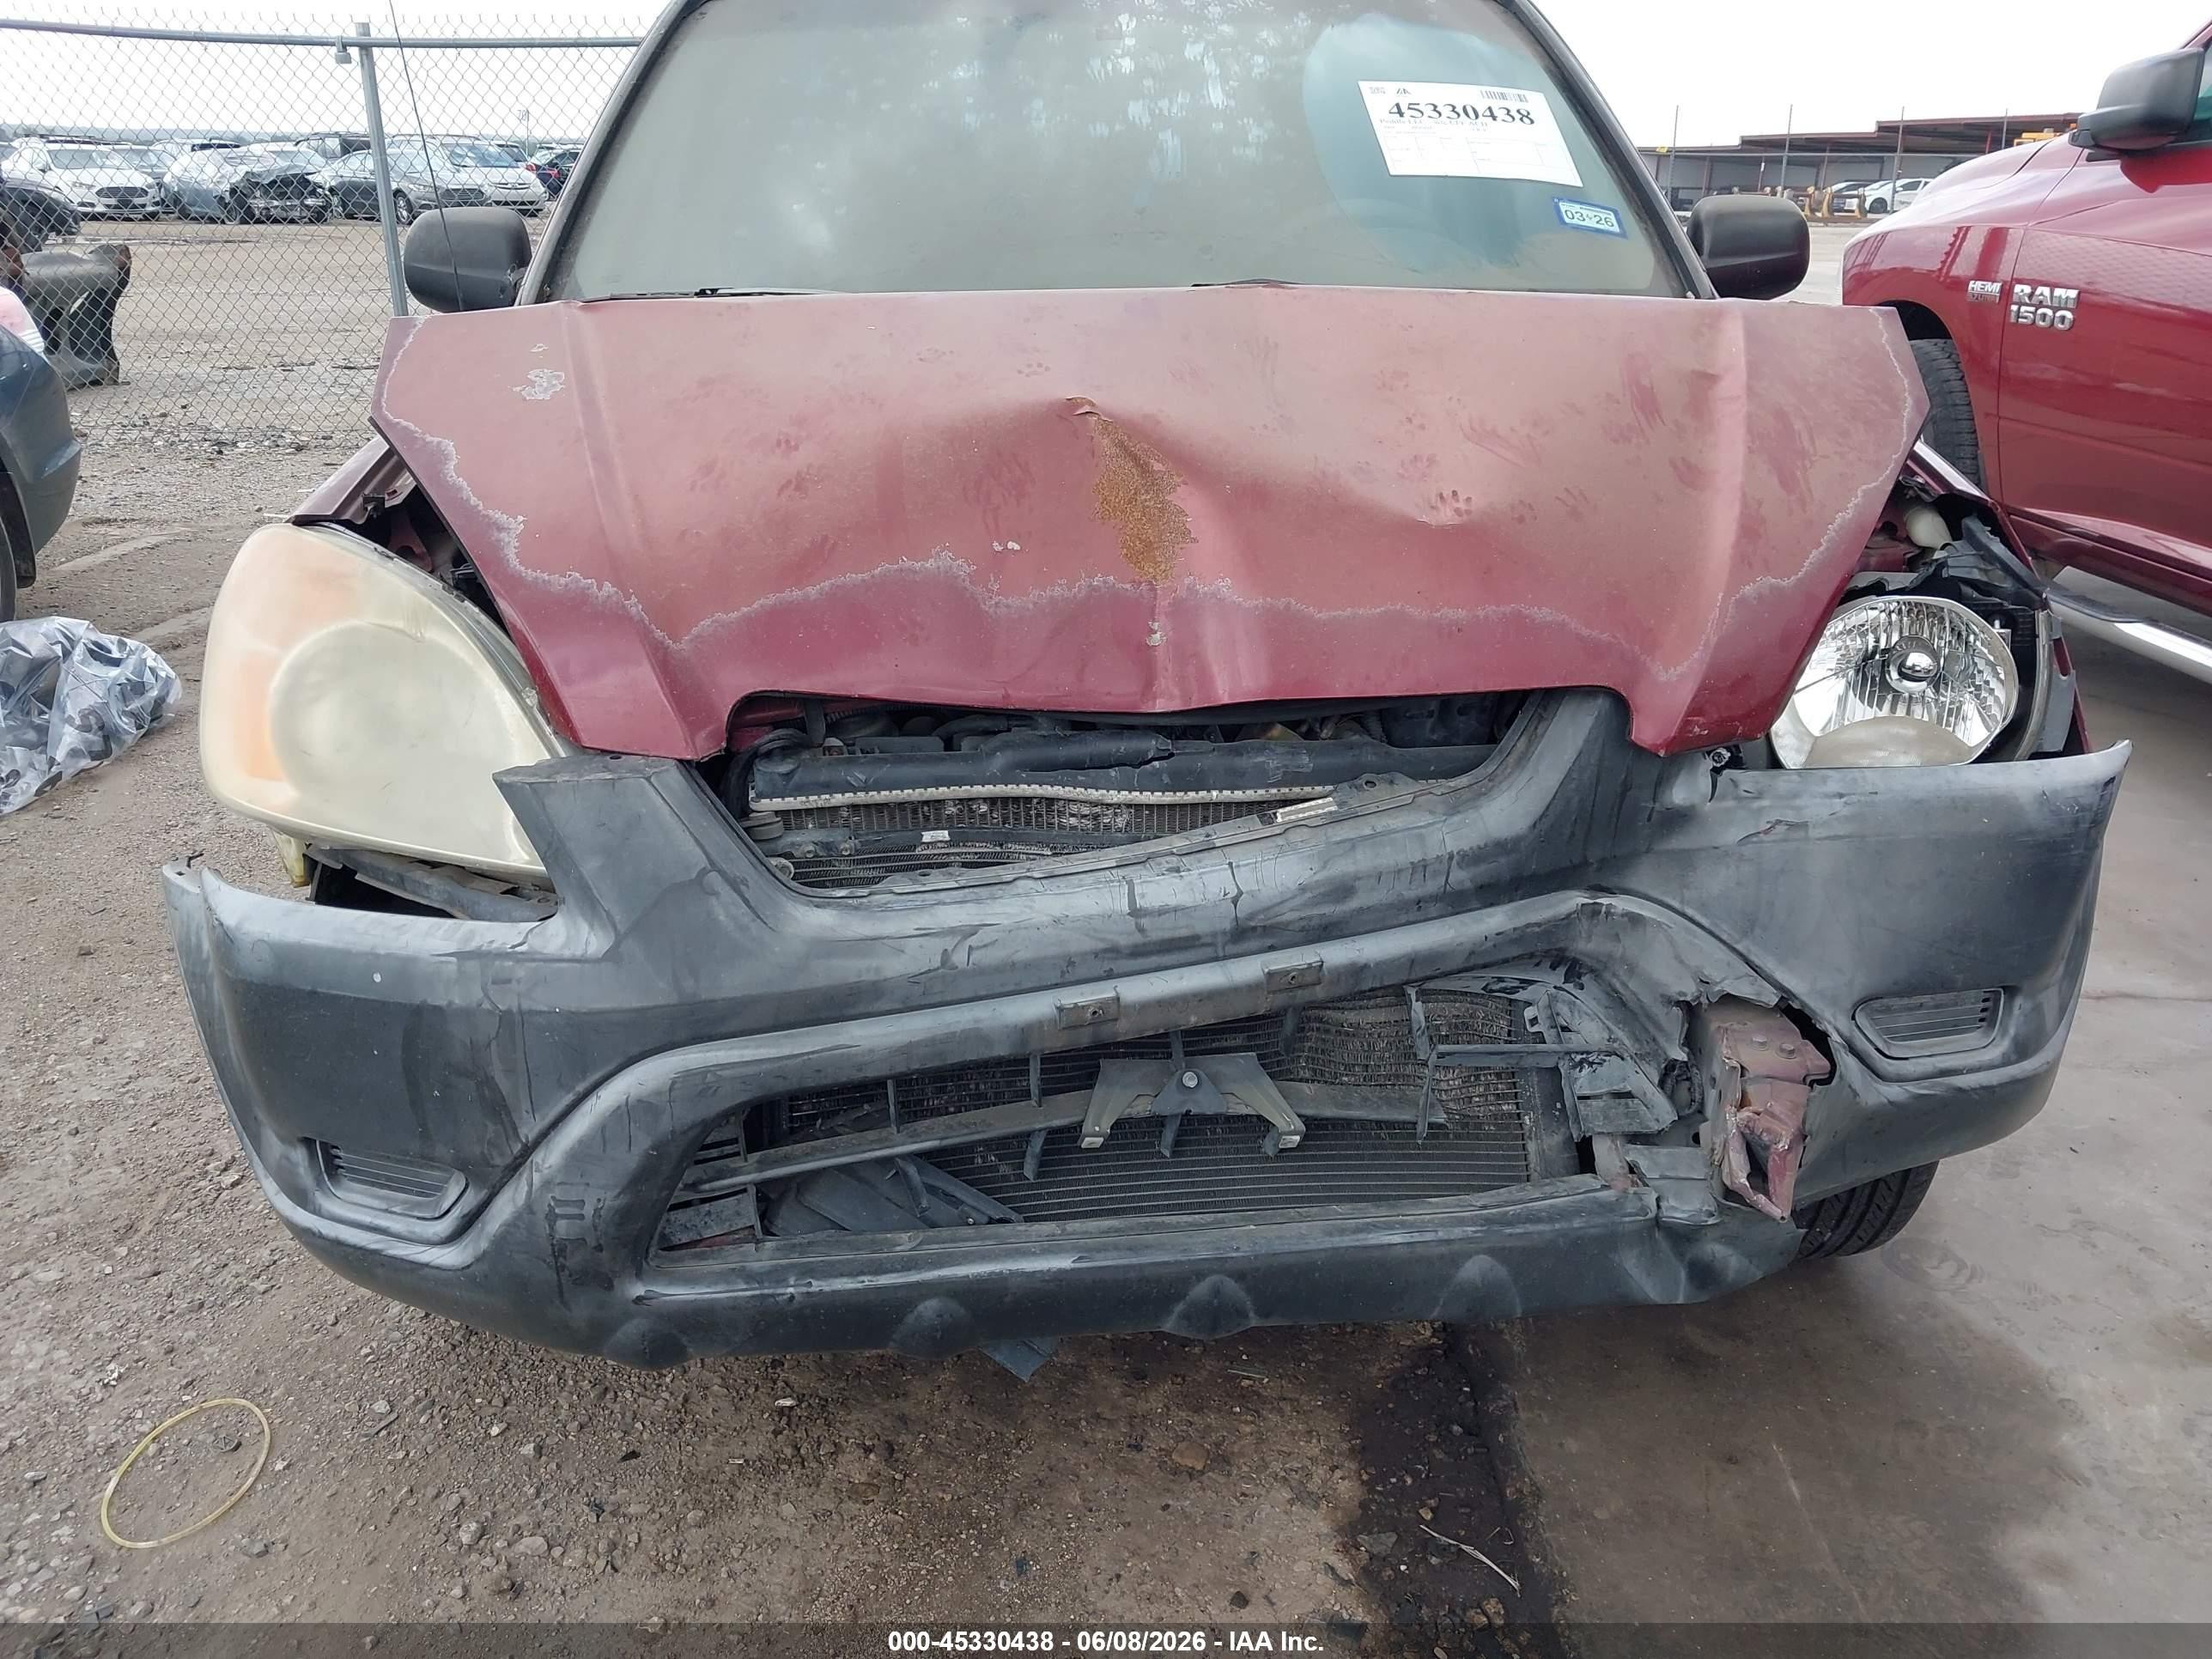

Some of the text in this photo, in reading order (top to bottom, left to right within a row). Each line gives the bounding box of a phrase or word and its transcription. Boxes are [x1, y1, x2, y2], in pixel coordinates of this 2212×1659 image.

[1388, 101, 1534, 125] 45330438
[1968, 280, 2002, 294] HEMI
[2013, 283, 2079, 307] RAM
[2009, 305, 2074, 331] 1500
